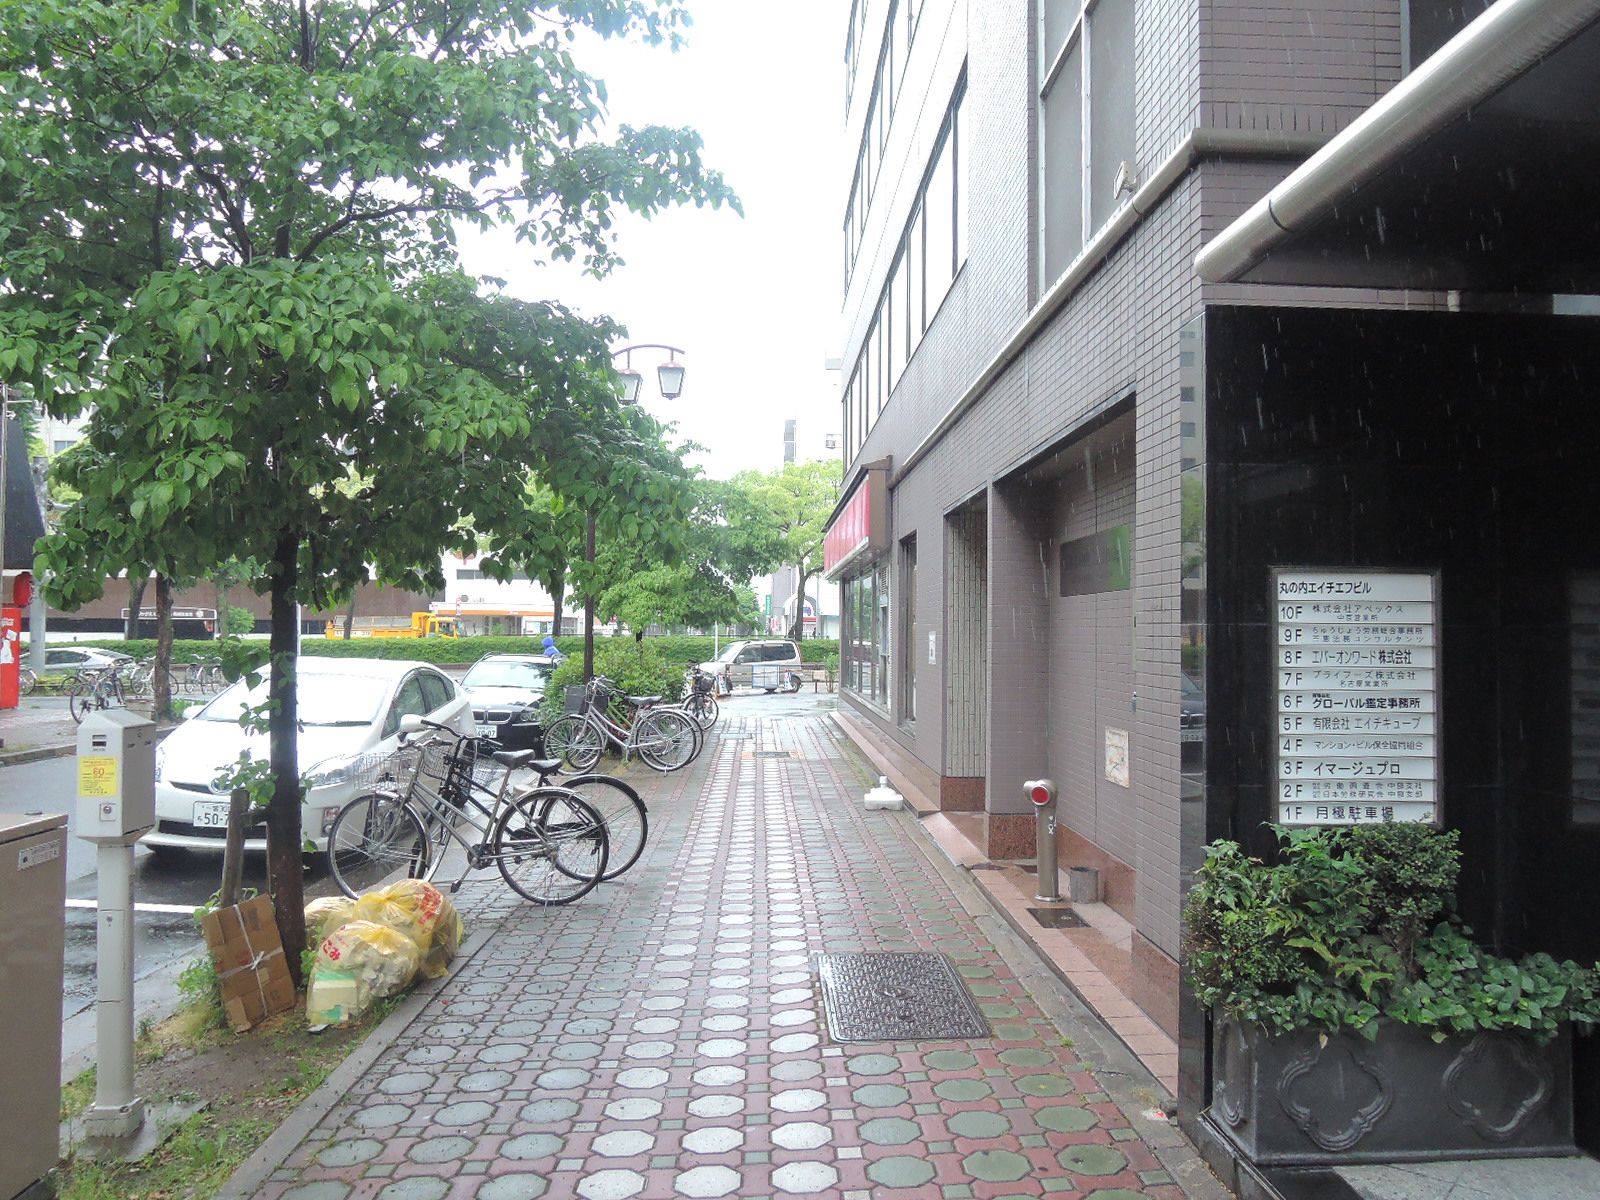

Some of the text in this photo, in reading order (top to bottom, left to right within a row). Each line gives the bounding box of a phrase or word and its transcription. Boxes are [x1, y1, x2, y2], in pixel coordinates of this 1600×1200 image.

[1279, 581, 1372, 594] 丸の内エイチエフビル
[1281, 606, 1303, 620] 10F
[1284, 629, 1302, 643] 9F
[1284, 650, 1302, 664] 8F
[1284, 672, 1303, 686] 7F
[1283, 695, 1303, 708] 6F
[1312, 697, 1421, 709] グローバル鑑定事務所
[1283, 717, 1302, 731] 5F
[1283, 739, 1303, 752] 4F
[1284, 761, 1303, 775] 3F
[1313, 761, 1401, 776] イマージュプロ
[1283, 784, 1303, 798] 2F
[1284, 806, 1303, 820] 1F
[1316, 805, 1394, 821] 月極駐車場
